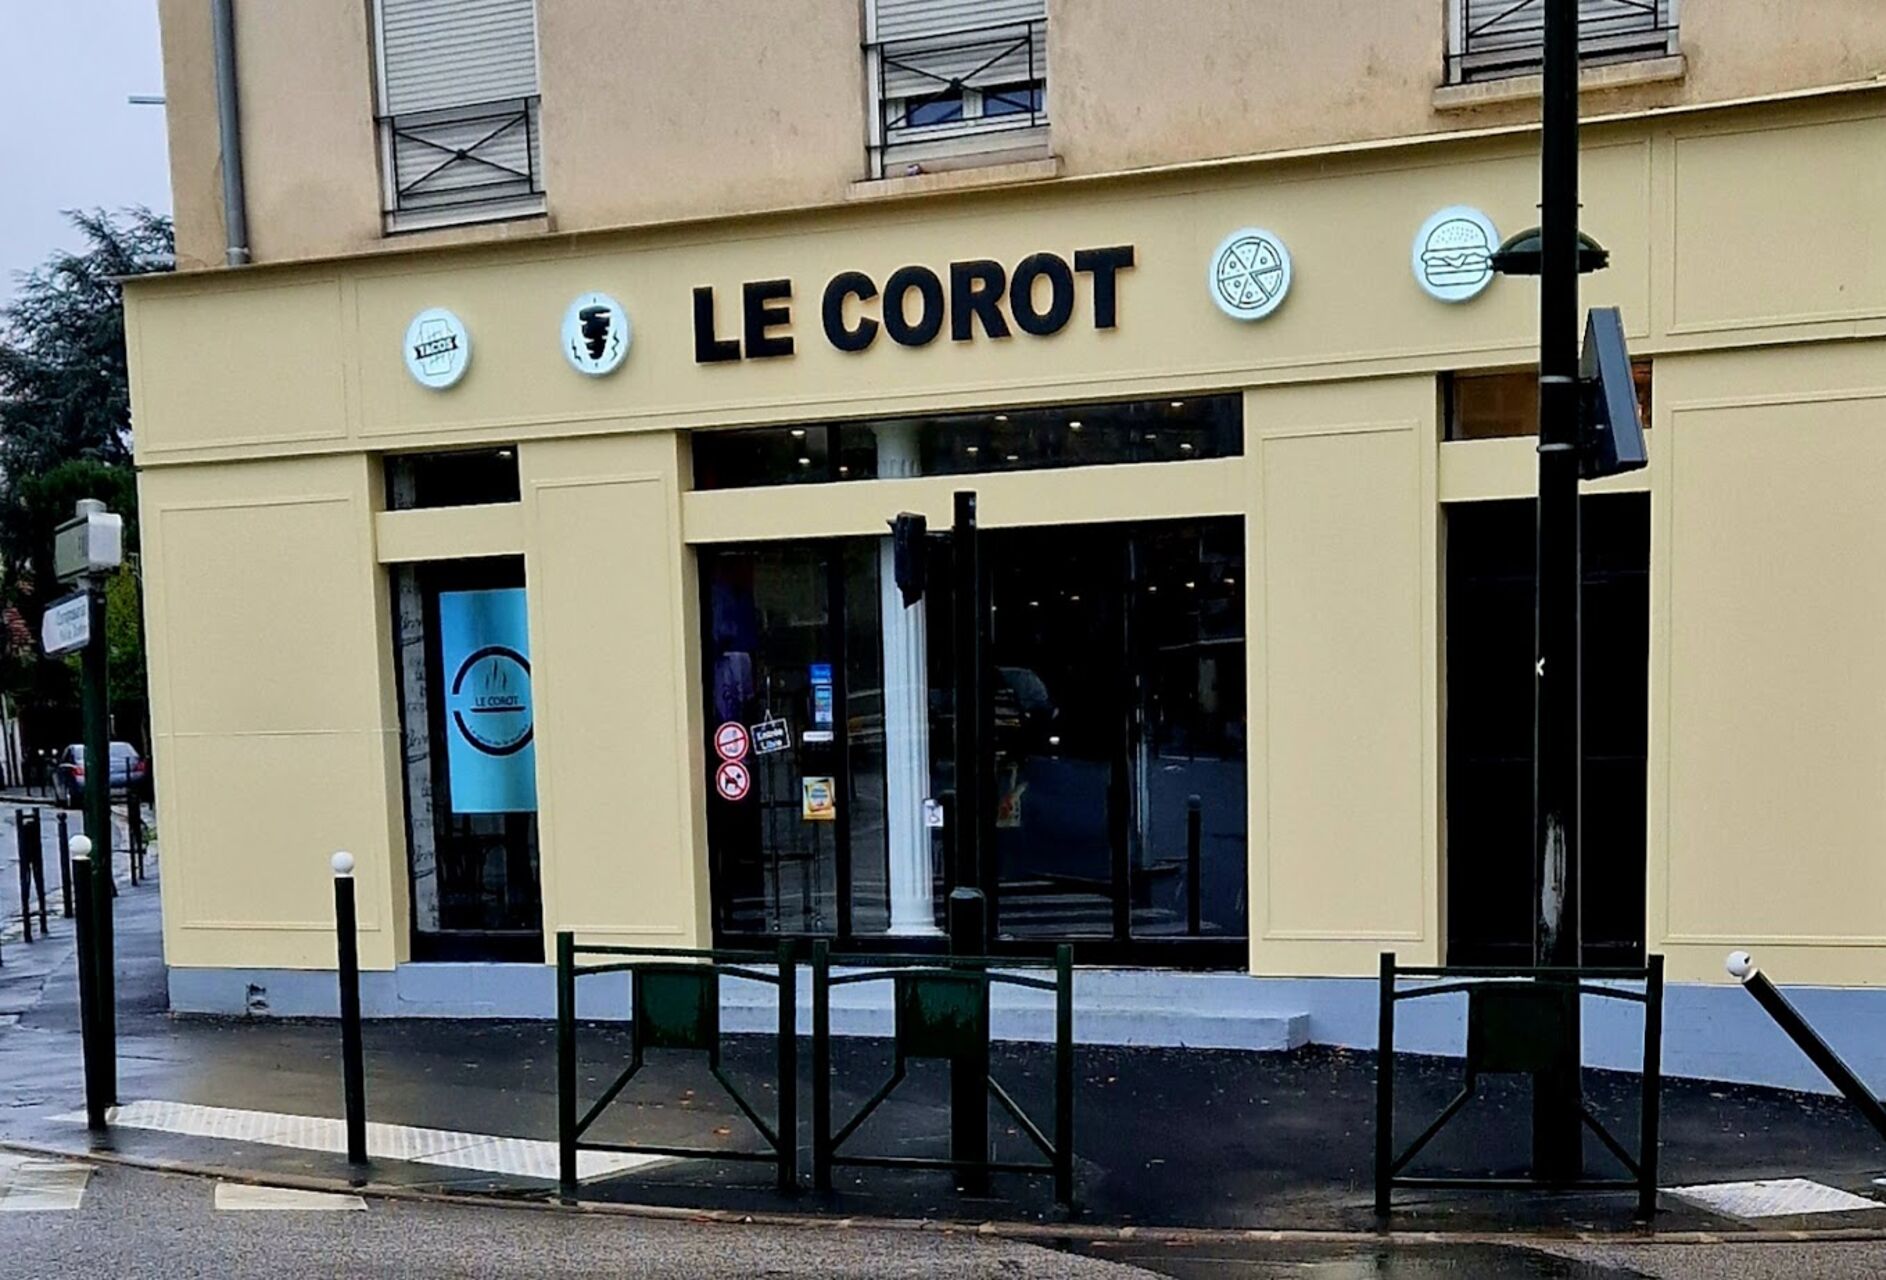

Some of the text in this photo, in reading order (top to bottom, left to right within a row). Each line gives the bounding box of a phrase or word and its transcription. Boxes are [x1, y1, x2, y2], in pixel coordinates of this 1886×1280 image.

[693, 245, 1135, 364] LE COROT
[419, 336, 453, 356] TACOS
[475, 695, 519, 706] LE COROT
